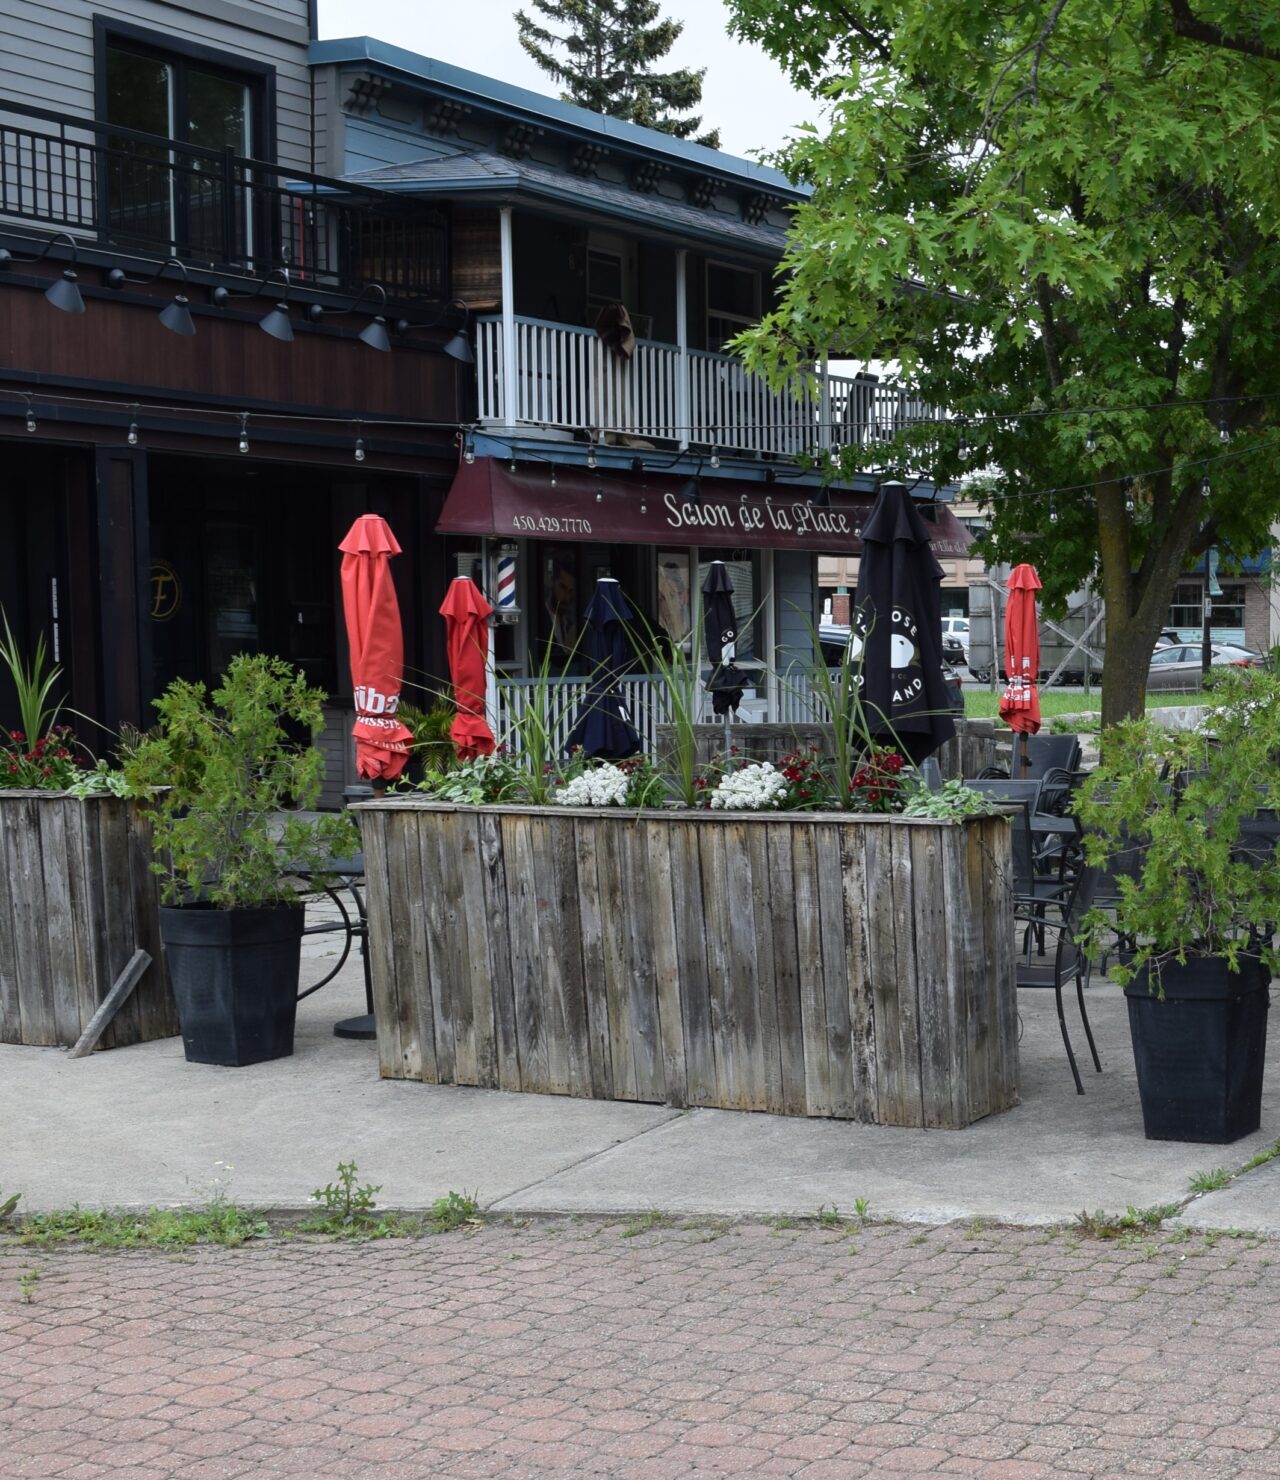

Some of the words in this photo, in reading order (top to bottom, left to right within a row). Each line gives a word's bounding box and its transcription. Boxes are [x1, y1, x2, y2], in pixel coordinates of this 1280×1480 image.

[512, 515, 592, 533] 450.429.7770
[739, 494, 765, 529] de
[765, 496, 792, 530] la
[791, 500, 850, 533] Place
